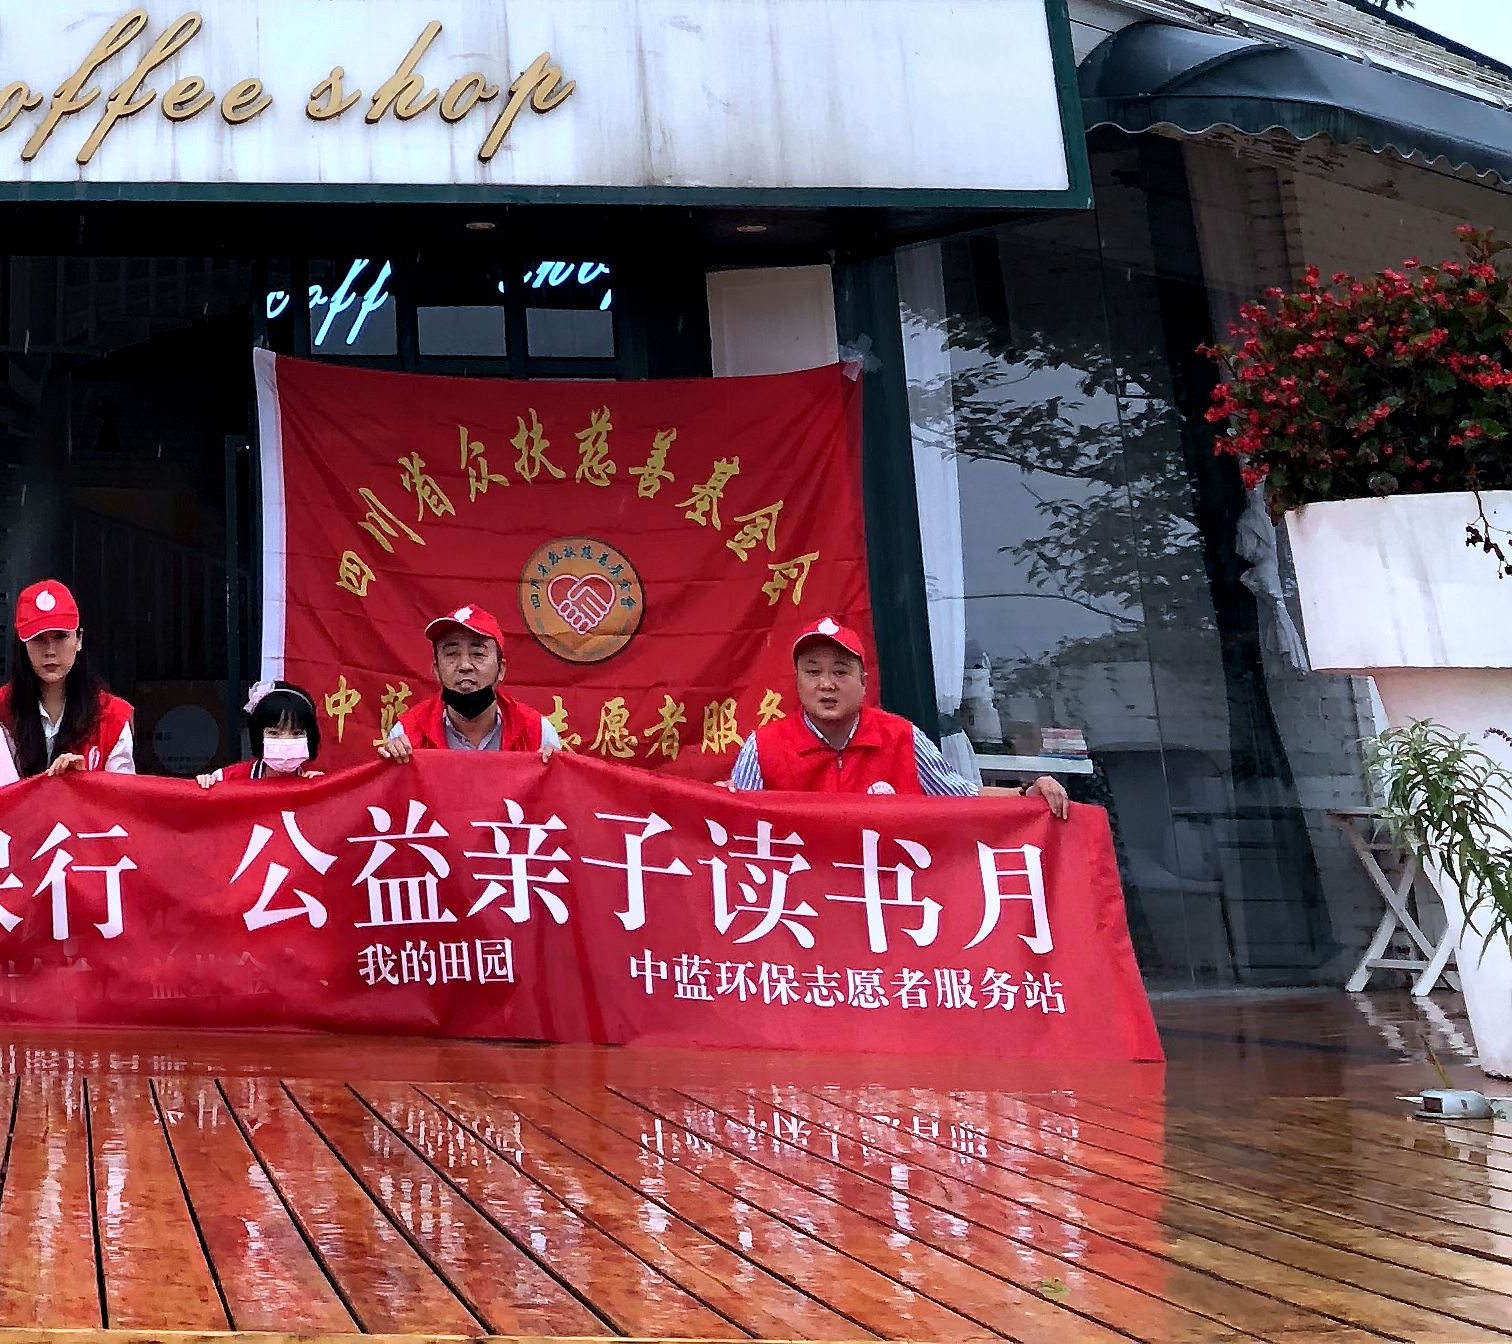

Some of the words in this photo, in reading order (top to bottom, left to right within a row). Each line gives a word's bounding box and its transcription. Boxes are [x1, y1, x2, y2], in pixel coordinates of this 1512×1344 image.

[305, 19, 576, 164] shop
[228, 797, 1055, 955] 公益亲子读书月
[357, 937, 515, 986] 我的田园
[628, 947, 1067, 1014] 中蓝环保志愿者服务站
